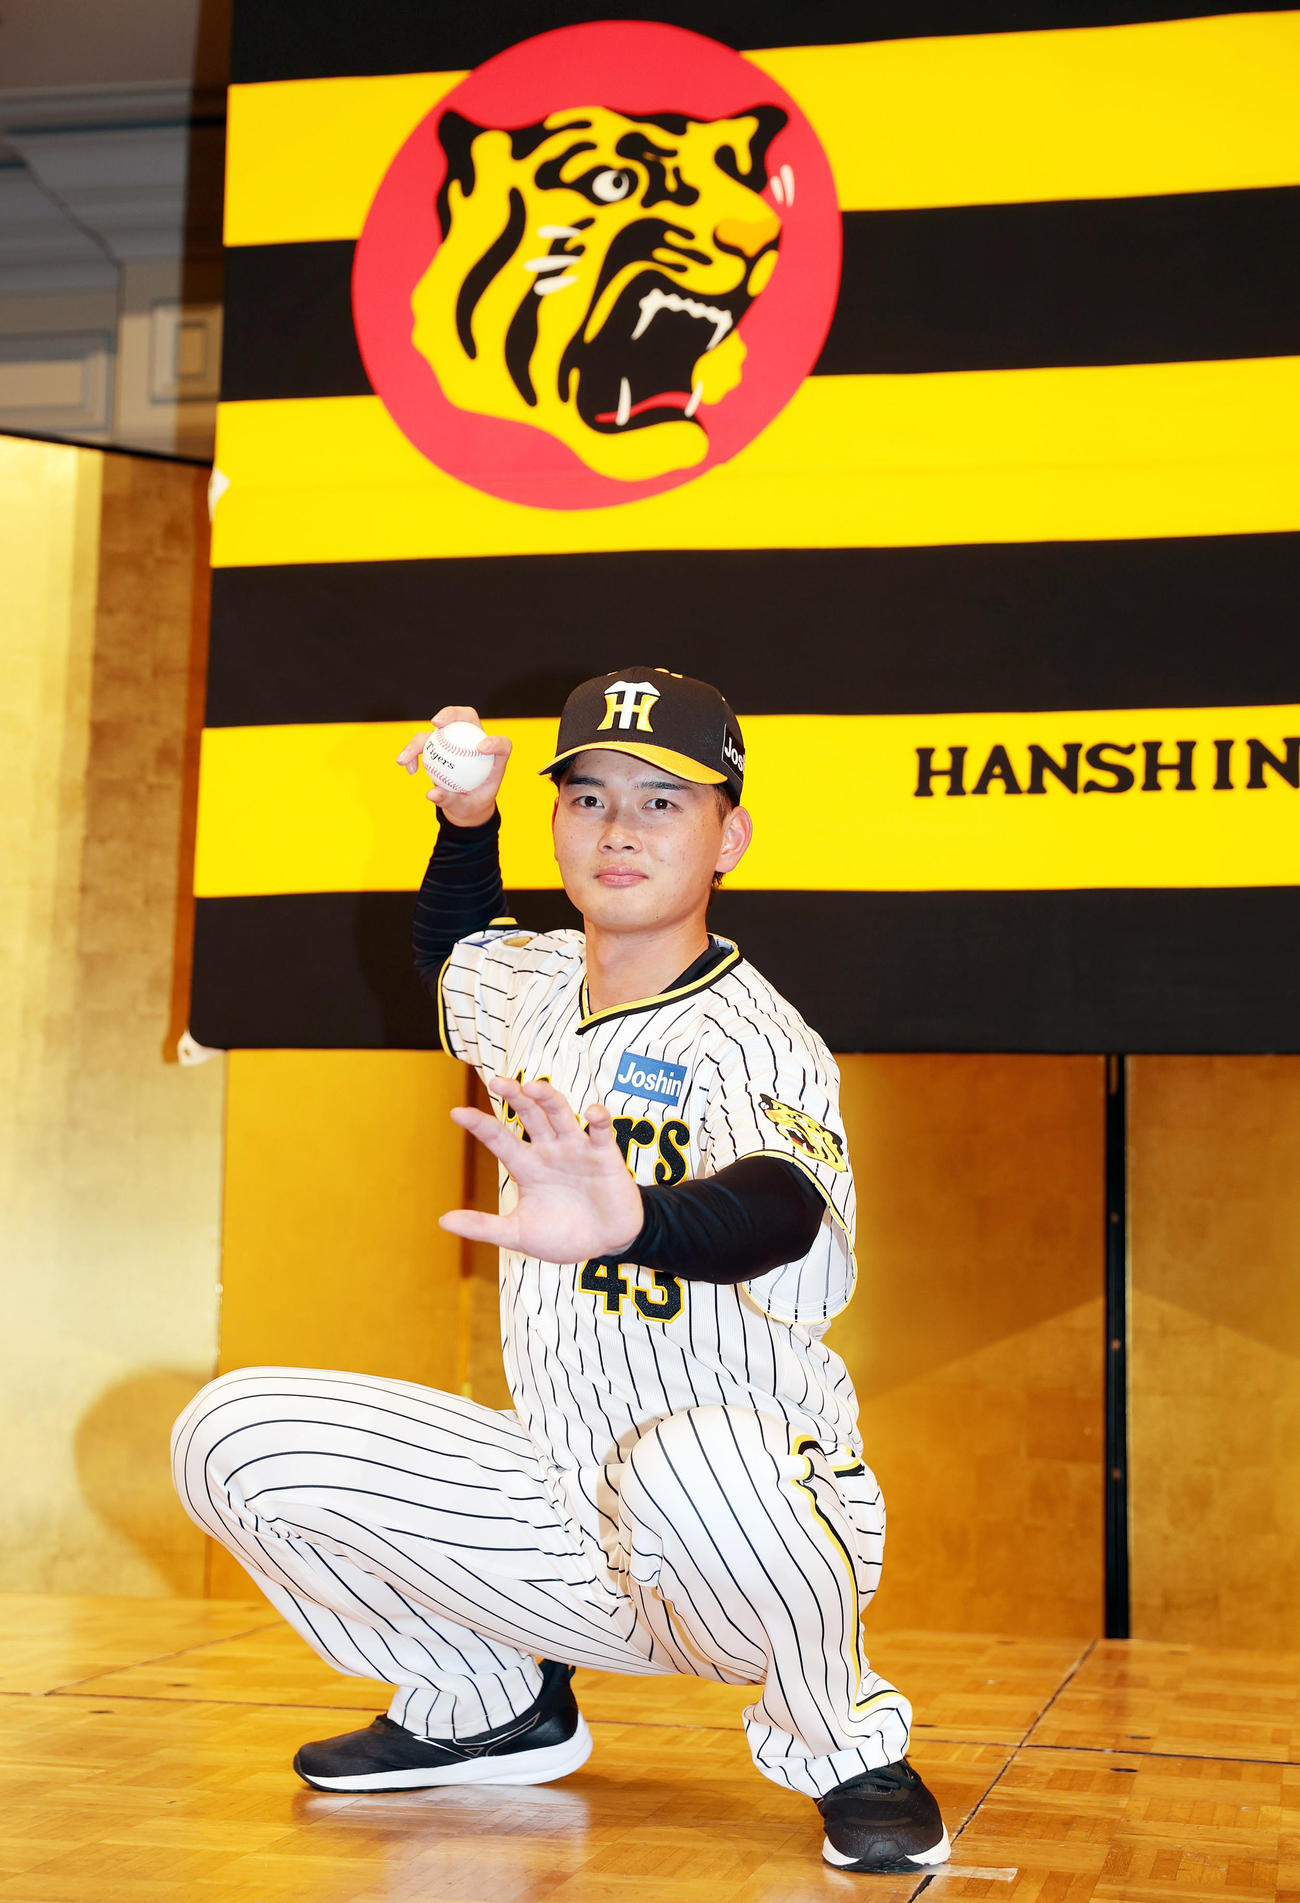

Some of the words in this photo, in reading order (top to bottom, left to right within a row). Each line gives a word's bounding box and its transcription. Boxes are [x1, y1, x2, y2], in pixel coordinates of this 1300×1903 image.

[425, 741, 456, 770] Tigers
[724, 736, 746, 775] Jos
[914, 736, 1300, 797] HANSHIN
[617, 1061, 682, 1098] Joshin
[578, 1258, 685, 1324] 43
